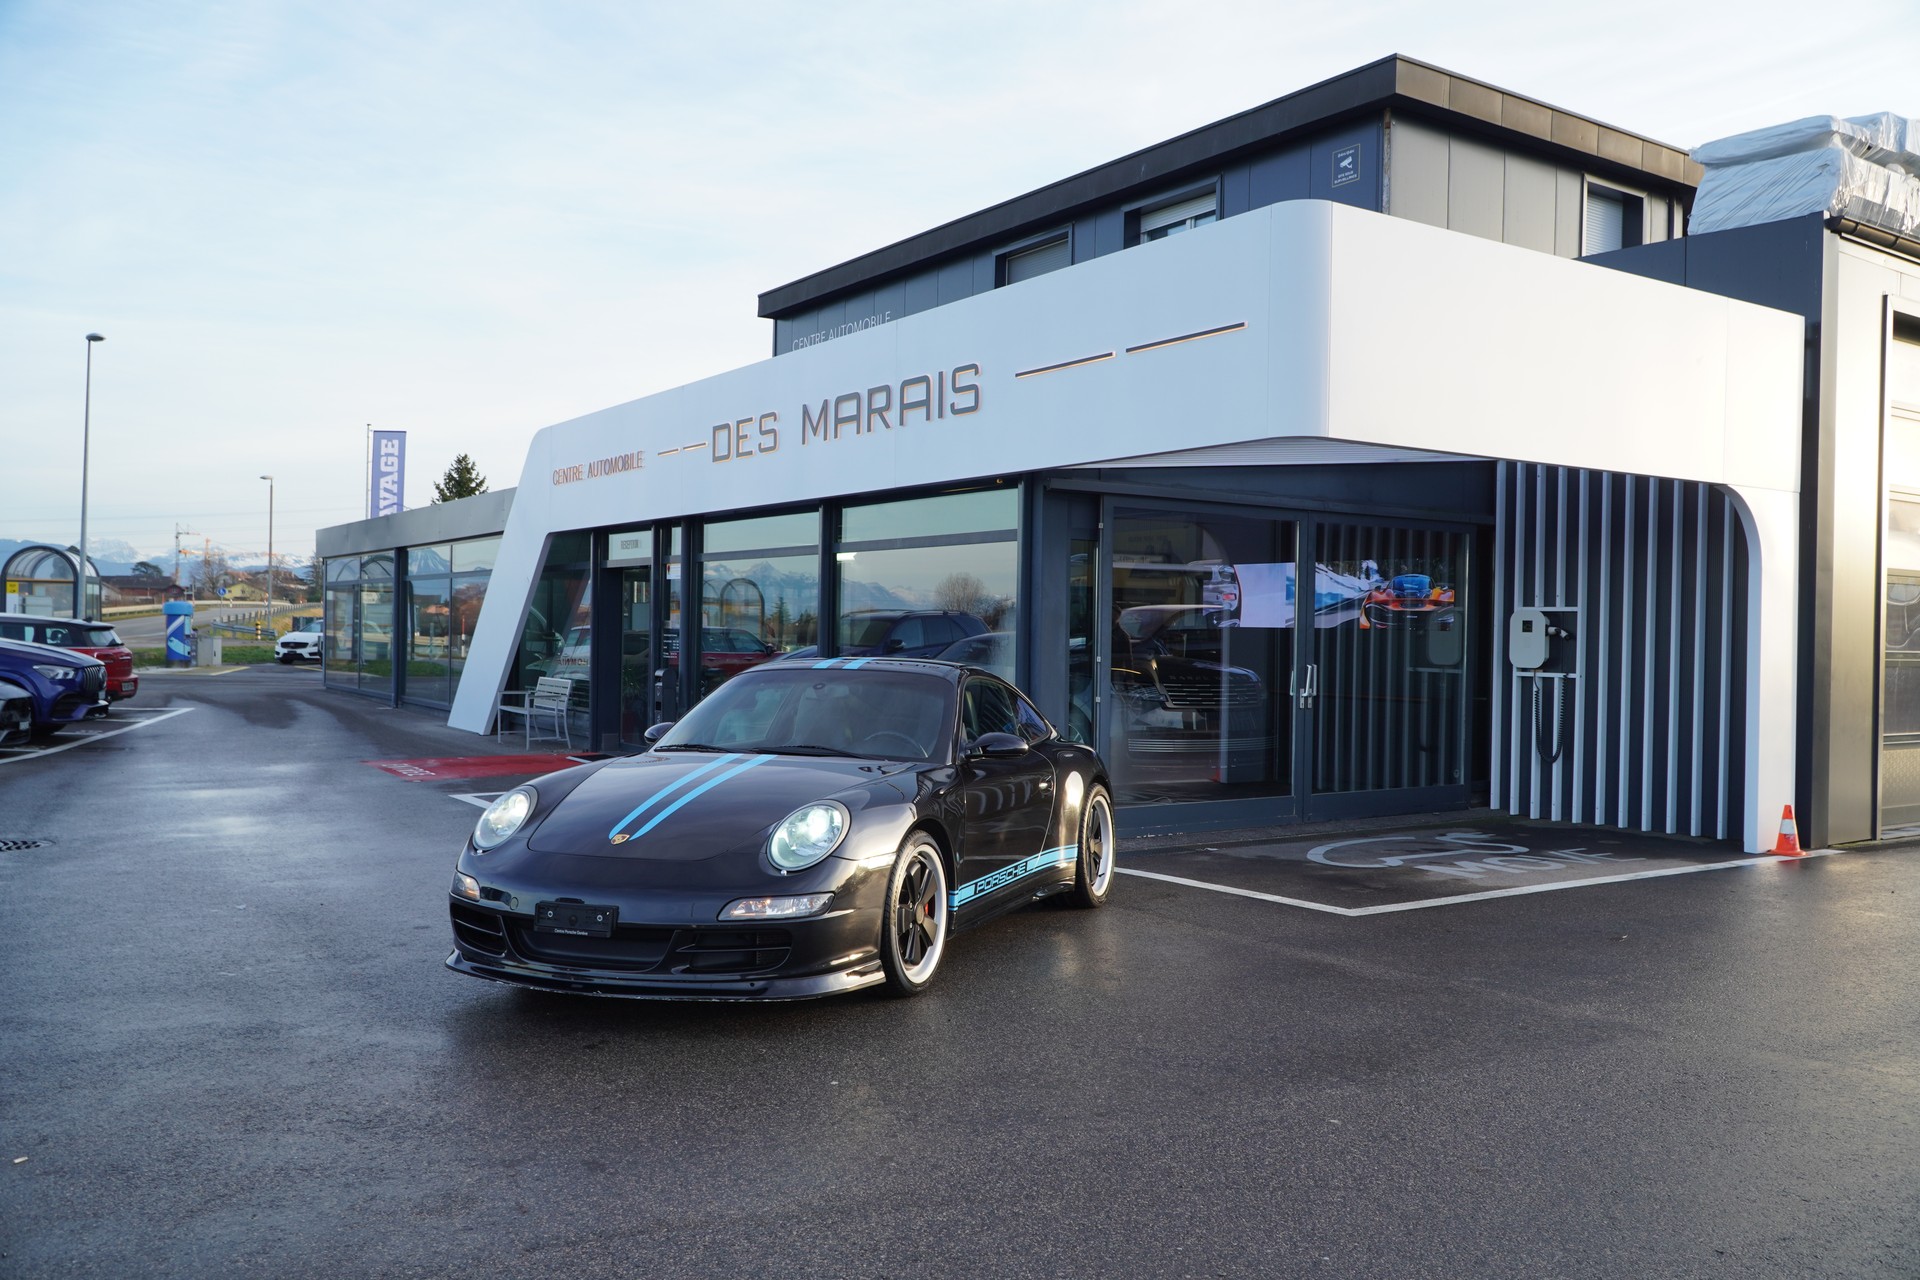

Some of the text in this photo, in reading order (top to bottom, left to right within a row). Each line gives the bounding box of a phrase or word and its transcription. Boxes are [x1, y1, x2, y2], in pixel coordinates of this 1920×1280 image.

[711, 363, 980, 463] DES MARAIS
[552, 450, 644, 486] CENTRE AUTOMOBILE
[975, 862, 1027, 893] PORSCHE
[1414, 848, 1648, 879] MOVE
